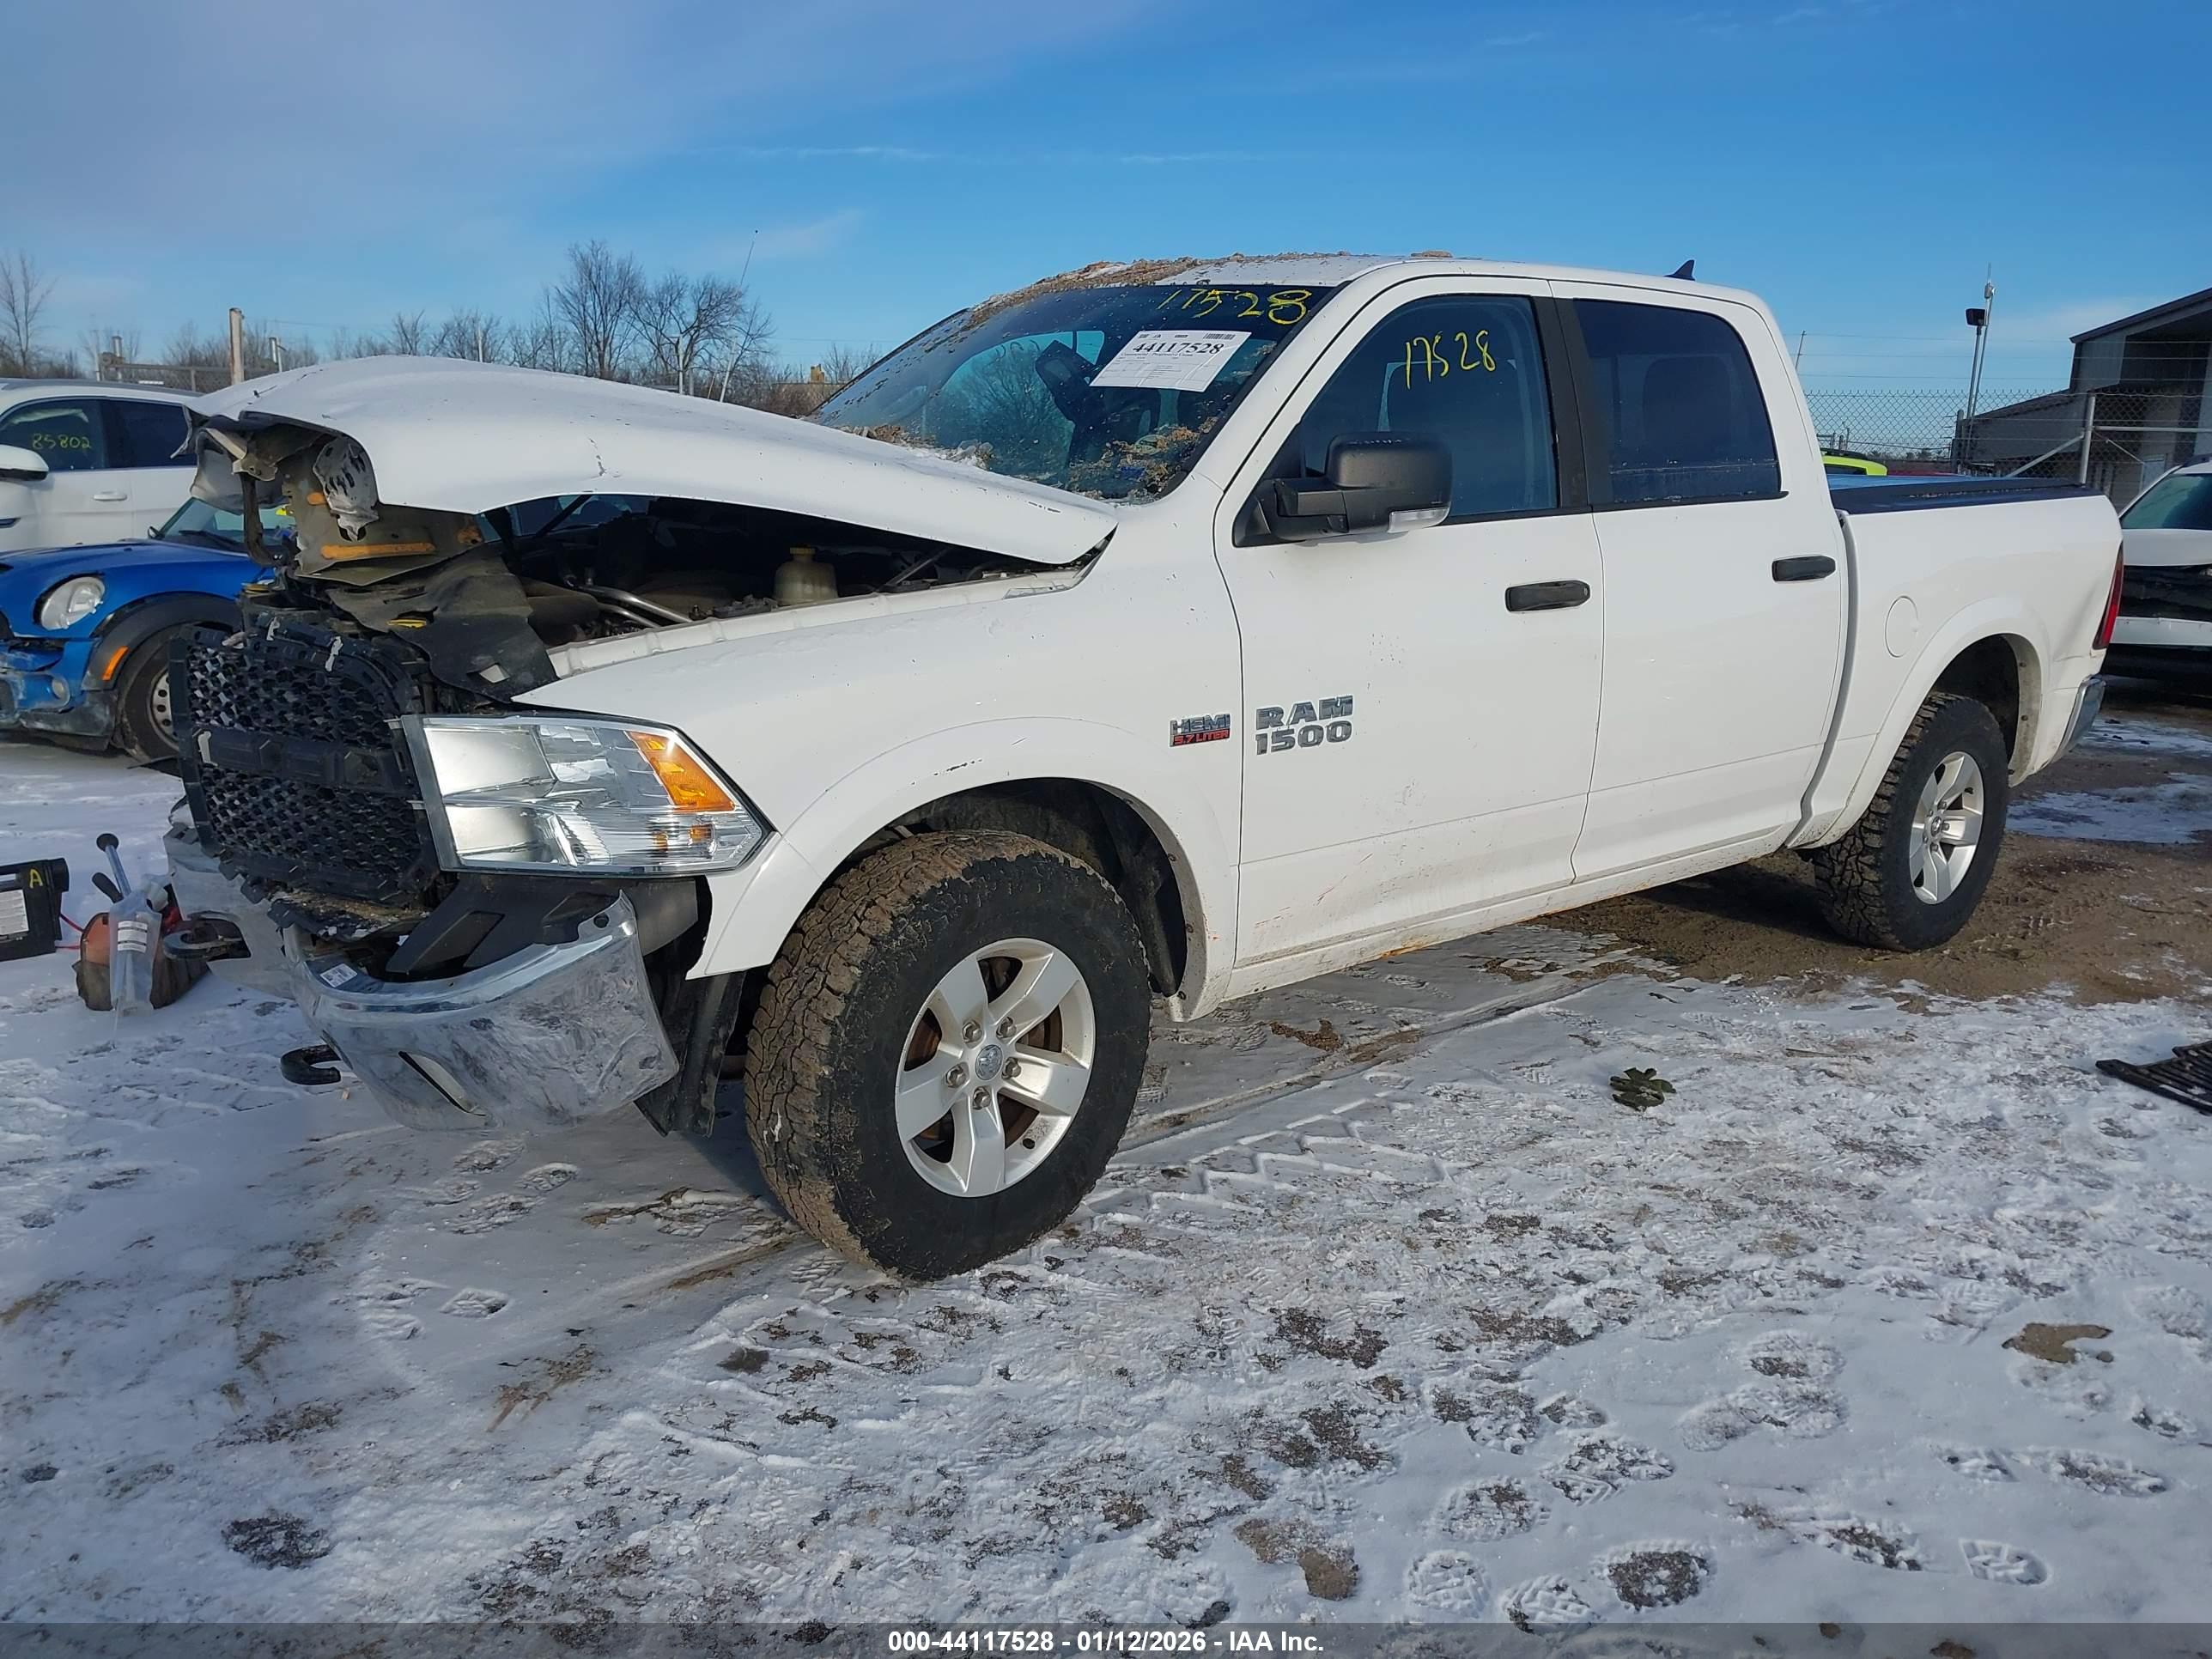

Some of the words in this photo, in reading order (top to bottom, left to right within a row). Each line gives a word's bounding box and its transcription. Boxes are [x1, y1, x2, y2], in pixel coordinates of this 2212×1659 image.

[1157, 288, 1313, 325] 17528
[1133, 342, 1224, 355] 44117528
[1404, 329, 1497, 390] 17528
[32, 434, 92, 449] 85802
[1255, 695, 1354, 731] RAM
[1170, 714, 1231, 736] HEMI
[1174, 733, 1194, 745] 5.7
[1196, 729, 1229, 744] LITER
[1255, 720, 1353, 756] 1500
[29, 868, 43, 889] A
